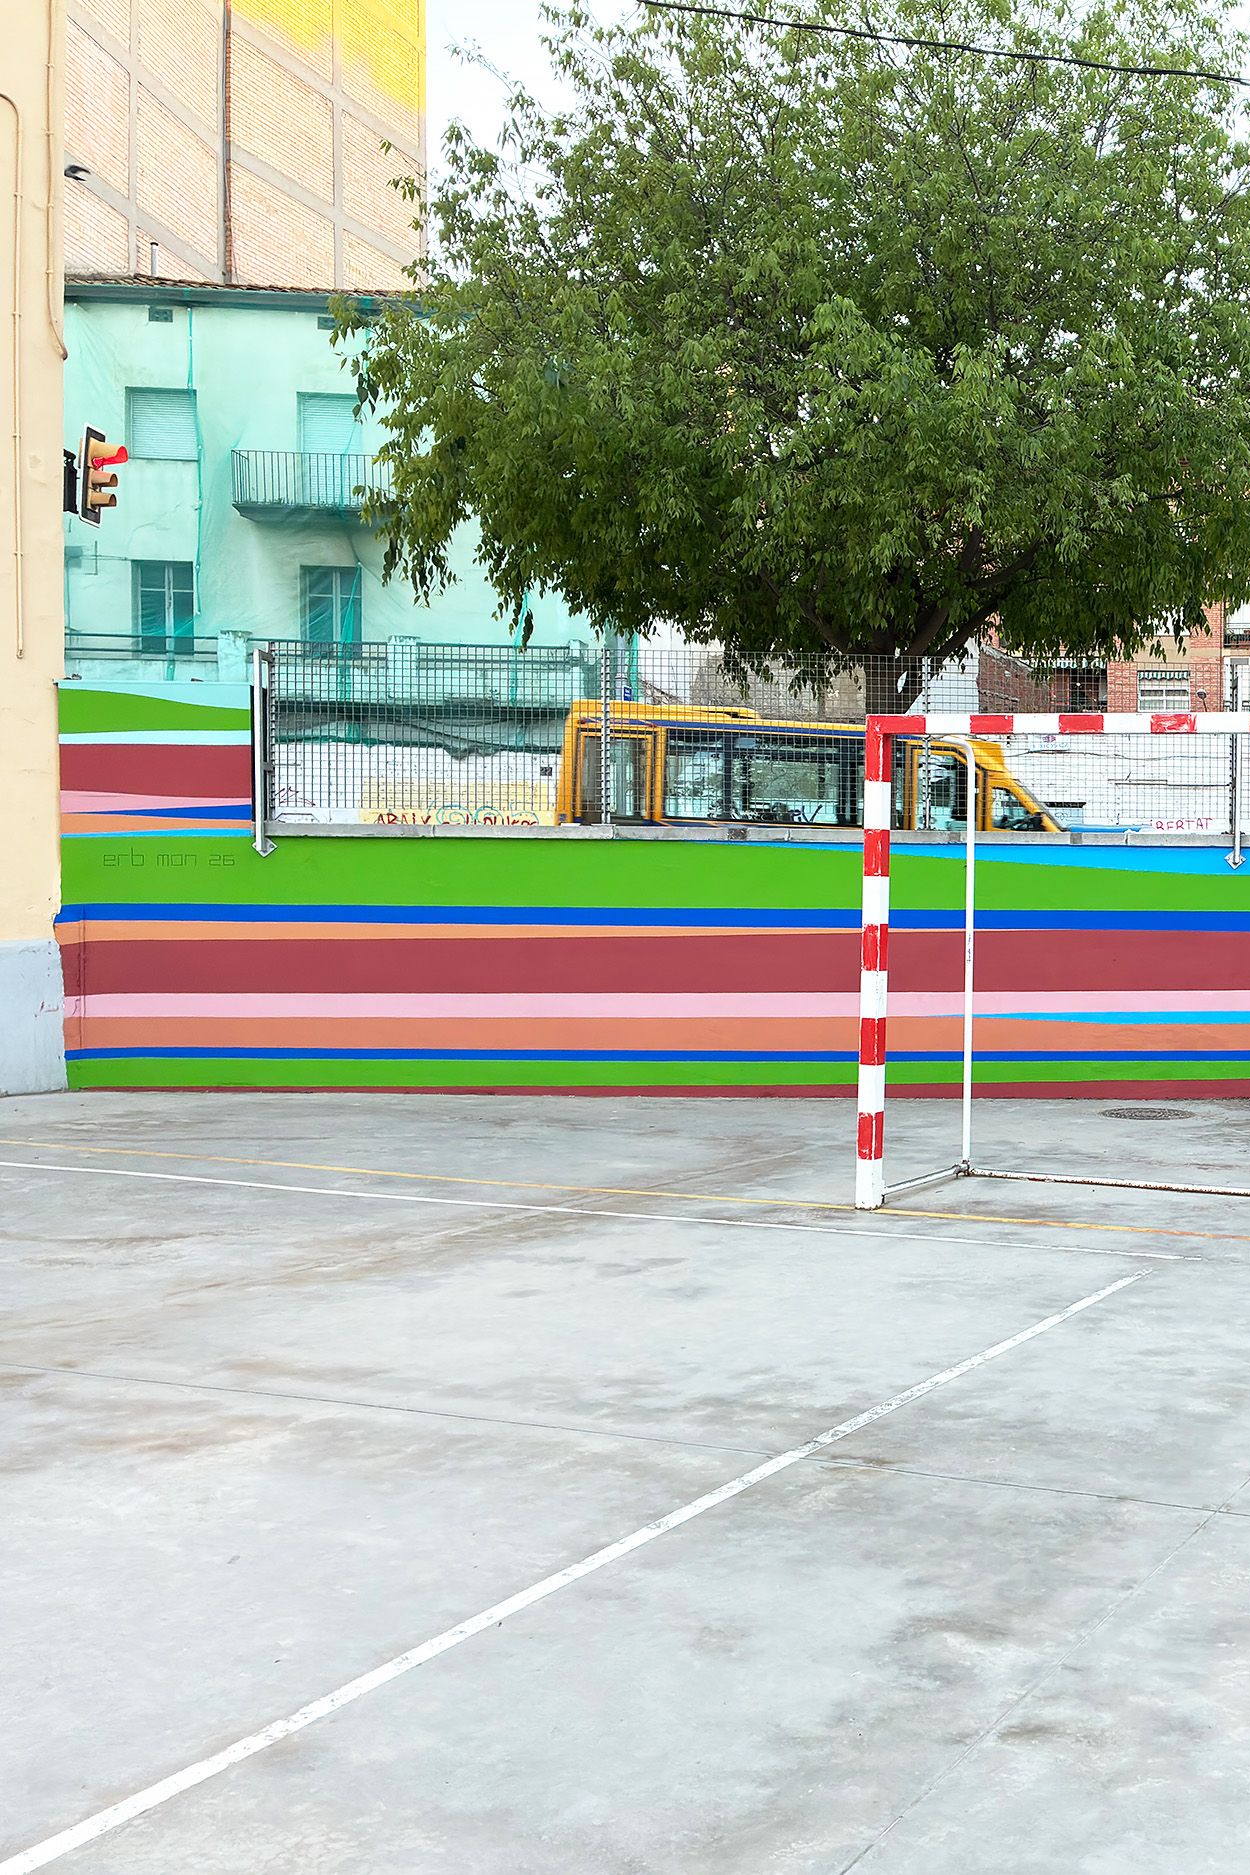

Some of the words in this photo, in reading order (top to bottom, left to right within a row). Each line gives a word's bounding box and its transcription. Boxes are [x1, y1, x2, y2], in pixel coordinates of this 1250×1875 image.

[103, 847, 145, 867] erb
[156, 854, 197, 867] mon
[208, 854, 236, 867] 26
